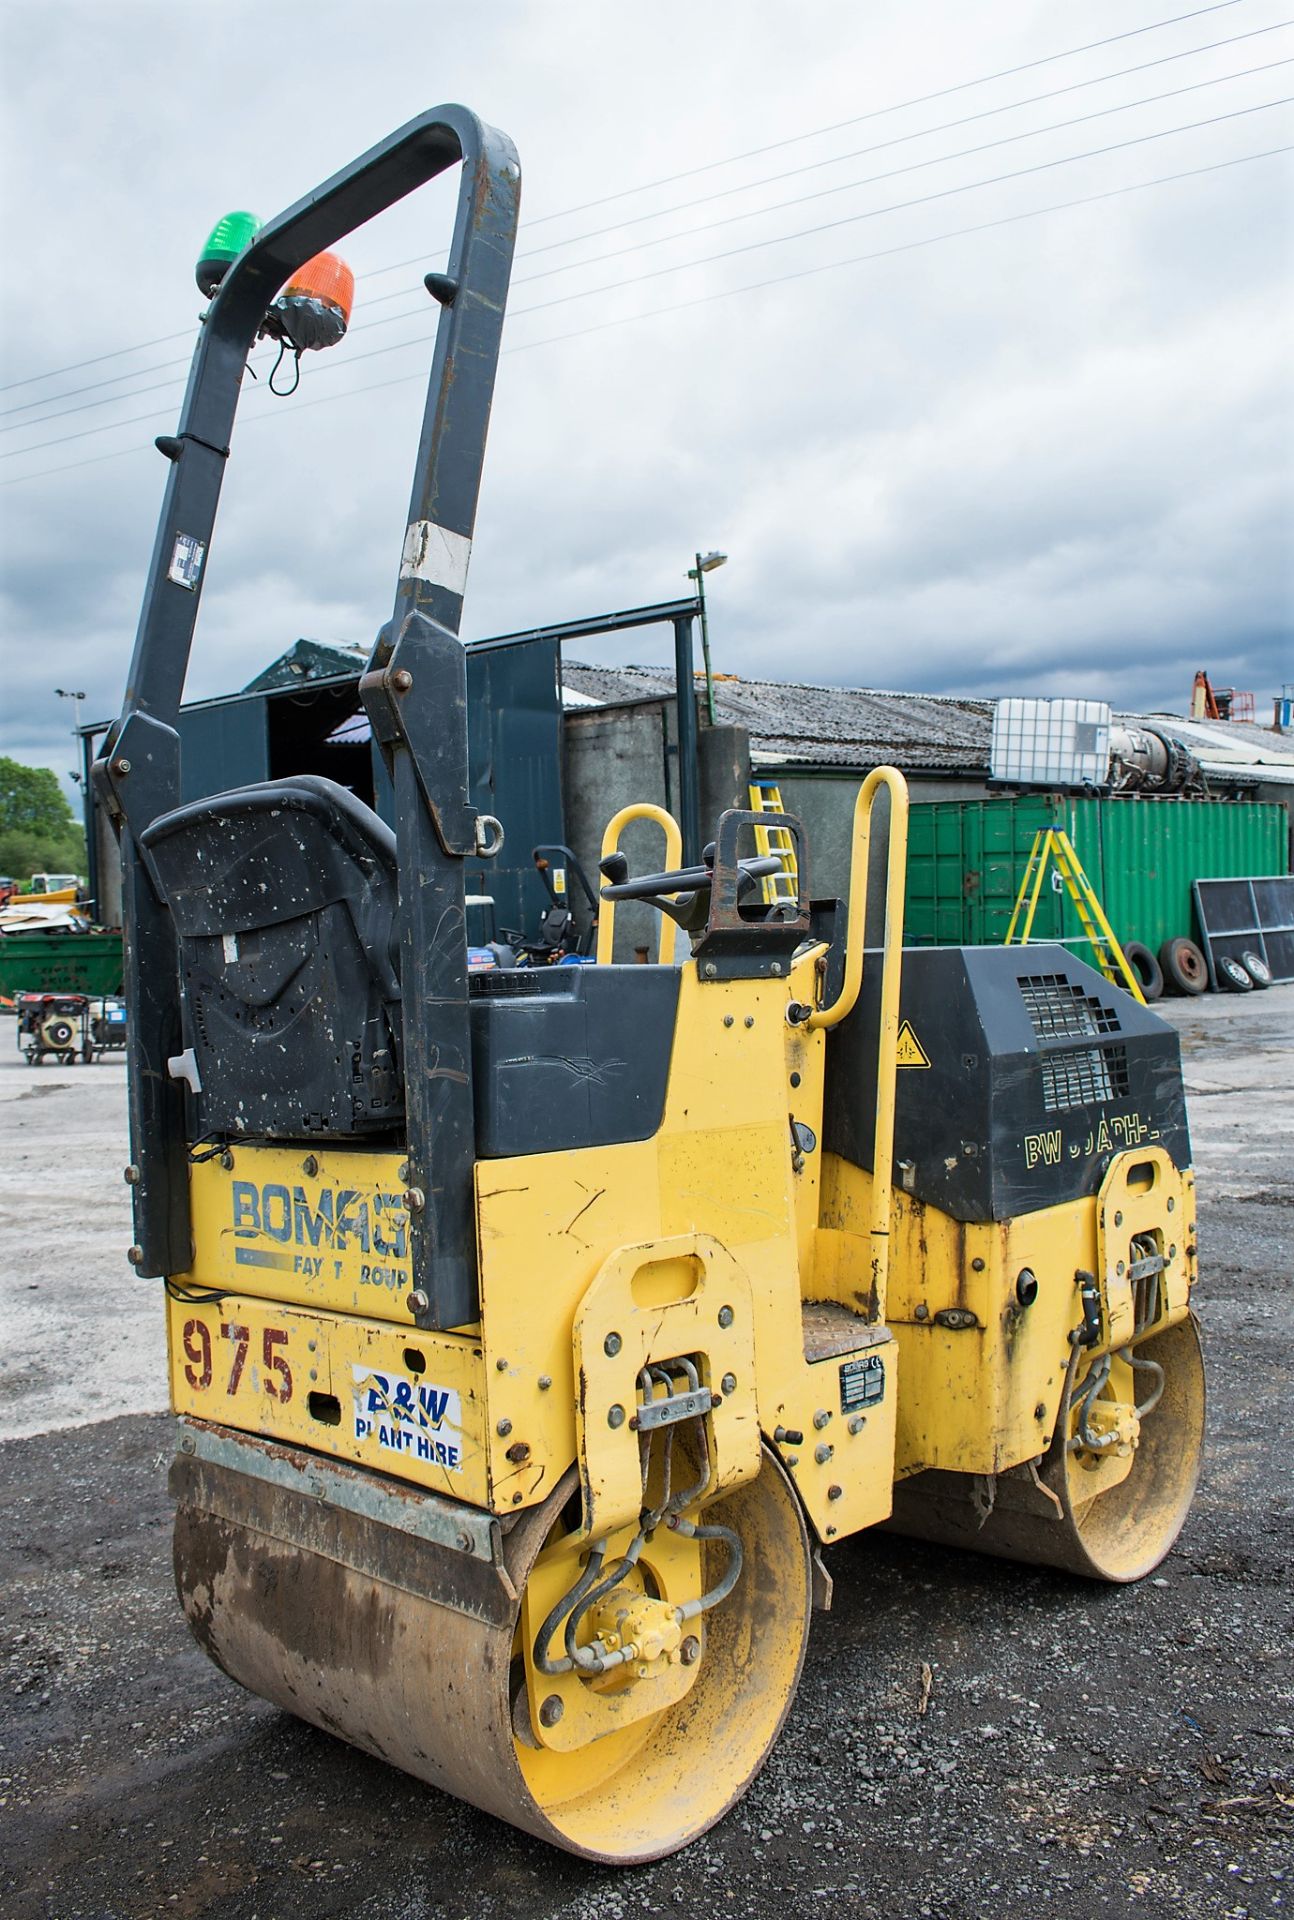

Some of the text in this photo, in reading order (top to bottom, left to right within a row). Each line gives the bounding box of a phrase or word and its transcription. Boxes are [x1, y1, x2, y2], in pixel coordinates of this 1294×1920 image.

[1024, 1130, 1062, 1169] BW
[232, 1181, 409, 1259] BOMAG
[359, 1264, 408, 1290] ROUP
[183, 1319, 293, 1404] 975
[417, 1436, 459, 1467] HIRE
